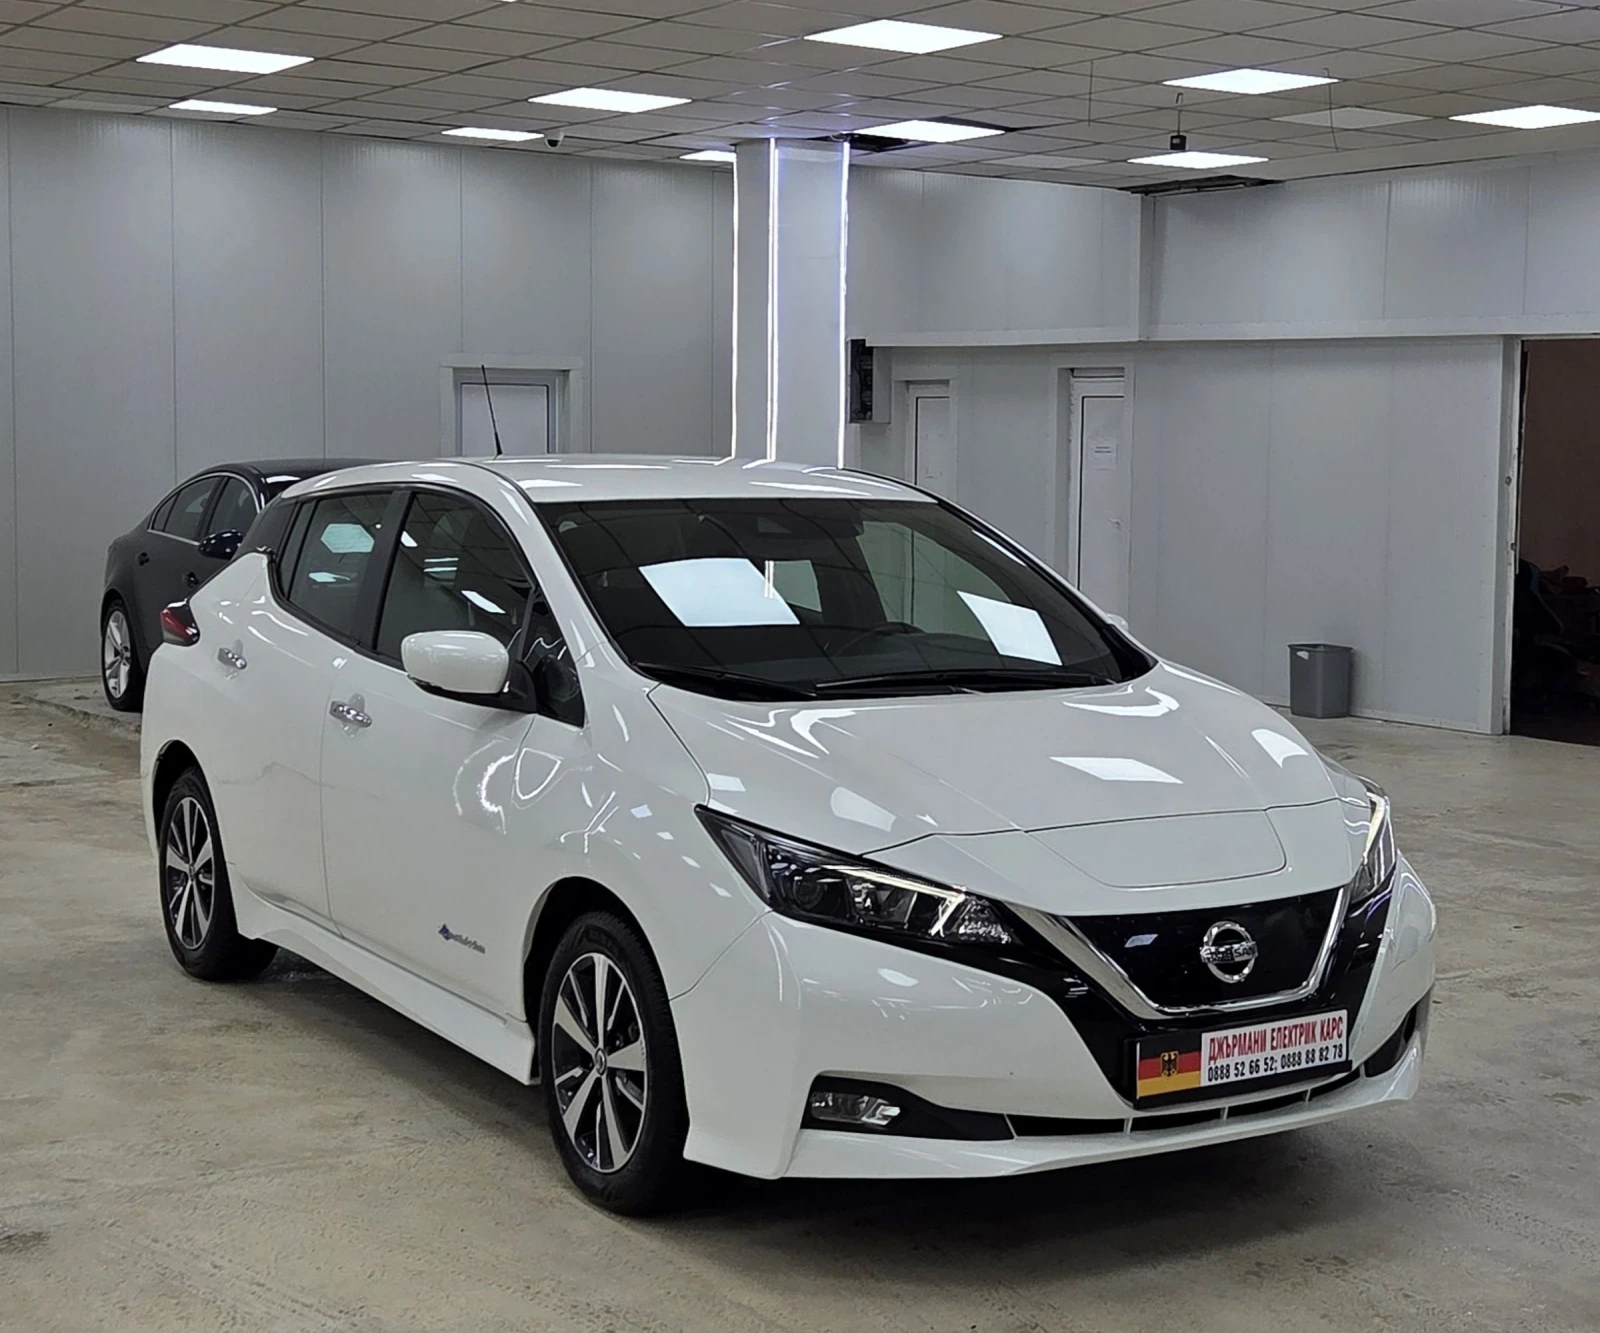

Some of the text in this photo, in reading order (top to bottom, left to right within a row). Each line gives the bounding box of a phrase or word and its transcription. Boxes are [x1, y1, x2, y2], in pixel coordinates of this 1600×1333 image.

[1208, 1016, 1343, 1066] ДЖЪРМАНИ ЕЛЕКТРИК КАРС
[1208, 1063, 1231, 1082] 0888
[1234, 1061, 1246, 1077] 52
[1249, 1058, 1260, 1075] 66
[1280, 1051, 1302, 1070] 0888
[1305, 1048, 1316, 1065] 88
[1319, 1045, 1330, 1062] 82
[1332, 1043, 1343, 1060] 78
